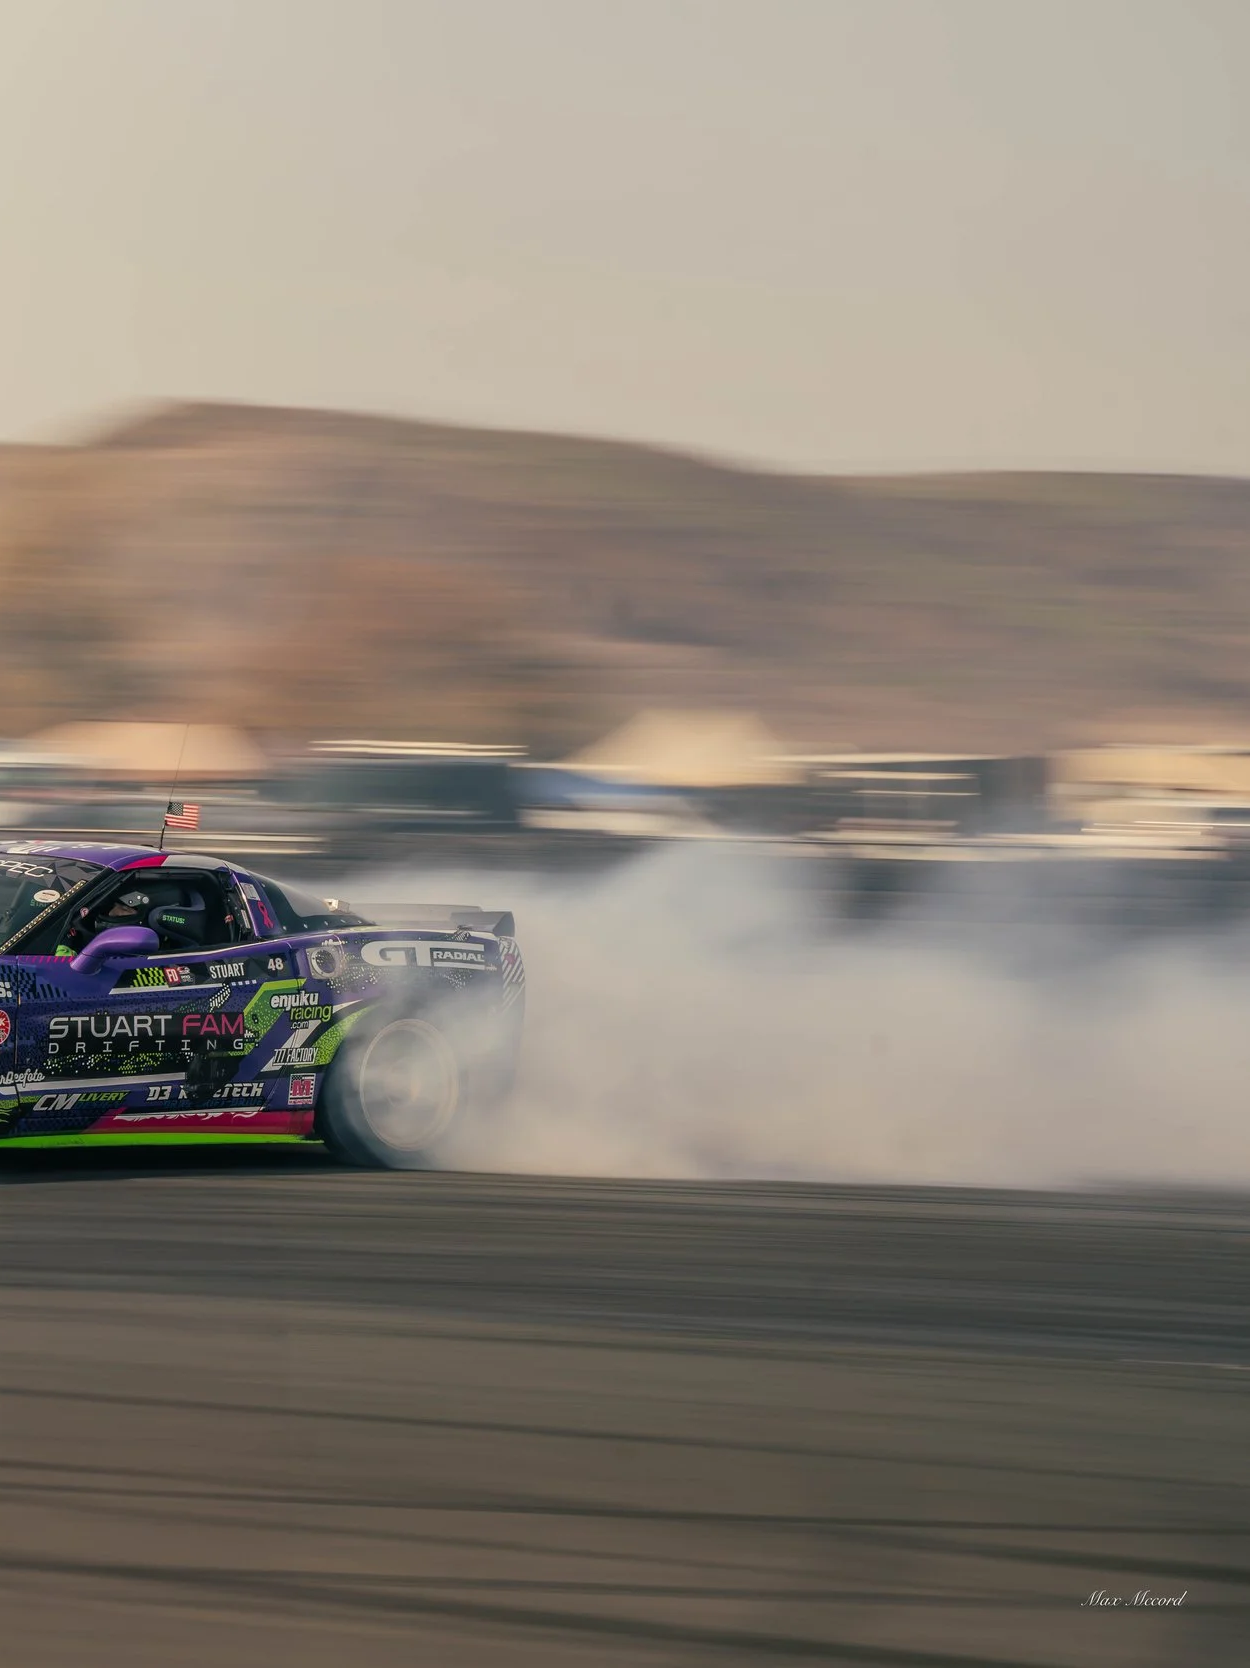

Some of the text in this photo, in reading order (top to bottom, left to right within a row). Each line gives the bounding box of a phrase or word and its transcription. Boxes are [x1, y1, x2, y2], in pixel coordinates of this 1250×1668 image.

[361, 941, 484, 968] GT
[433, 951, 485, 962] RADIAL
[210, 962, 244, 979] STUART
[268, 957, 284, 971] 48
[166, 968, 179, 982] FD
[271, 990, 319, 1011] enjuku
[290, 1006, 331, 1022] racing
[182, 1014, 244, 1036] FAM
[290, 1021, 309, 1029] .com
[287, 1047, 319, 1063] FACTORY
[33, 1092, 127, 1111] CM LIVERY
